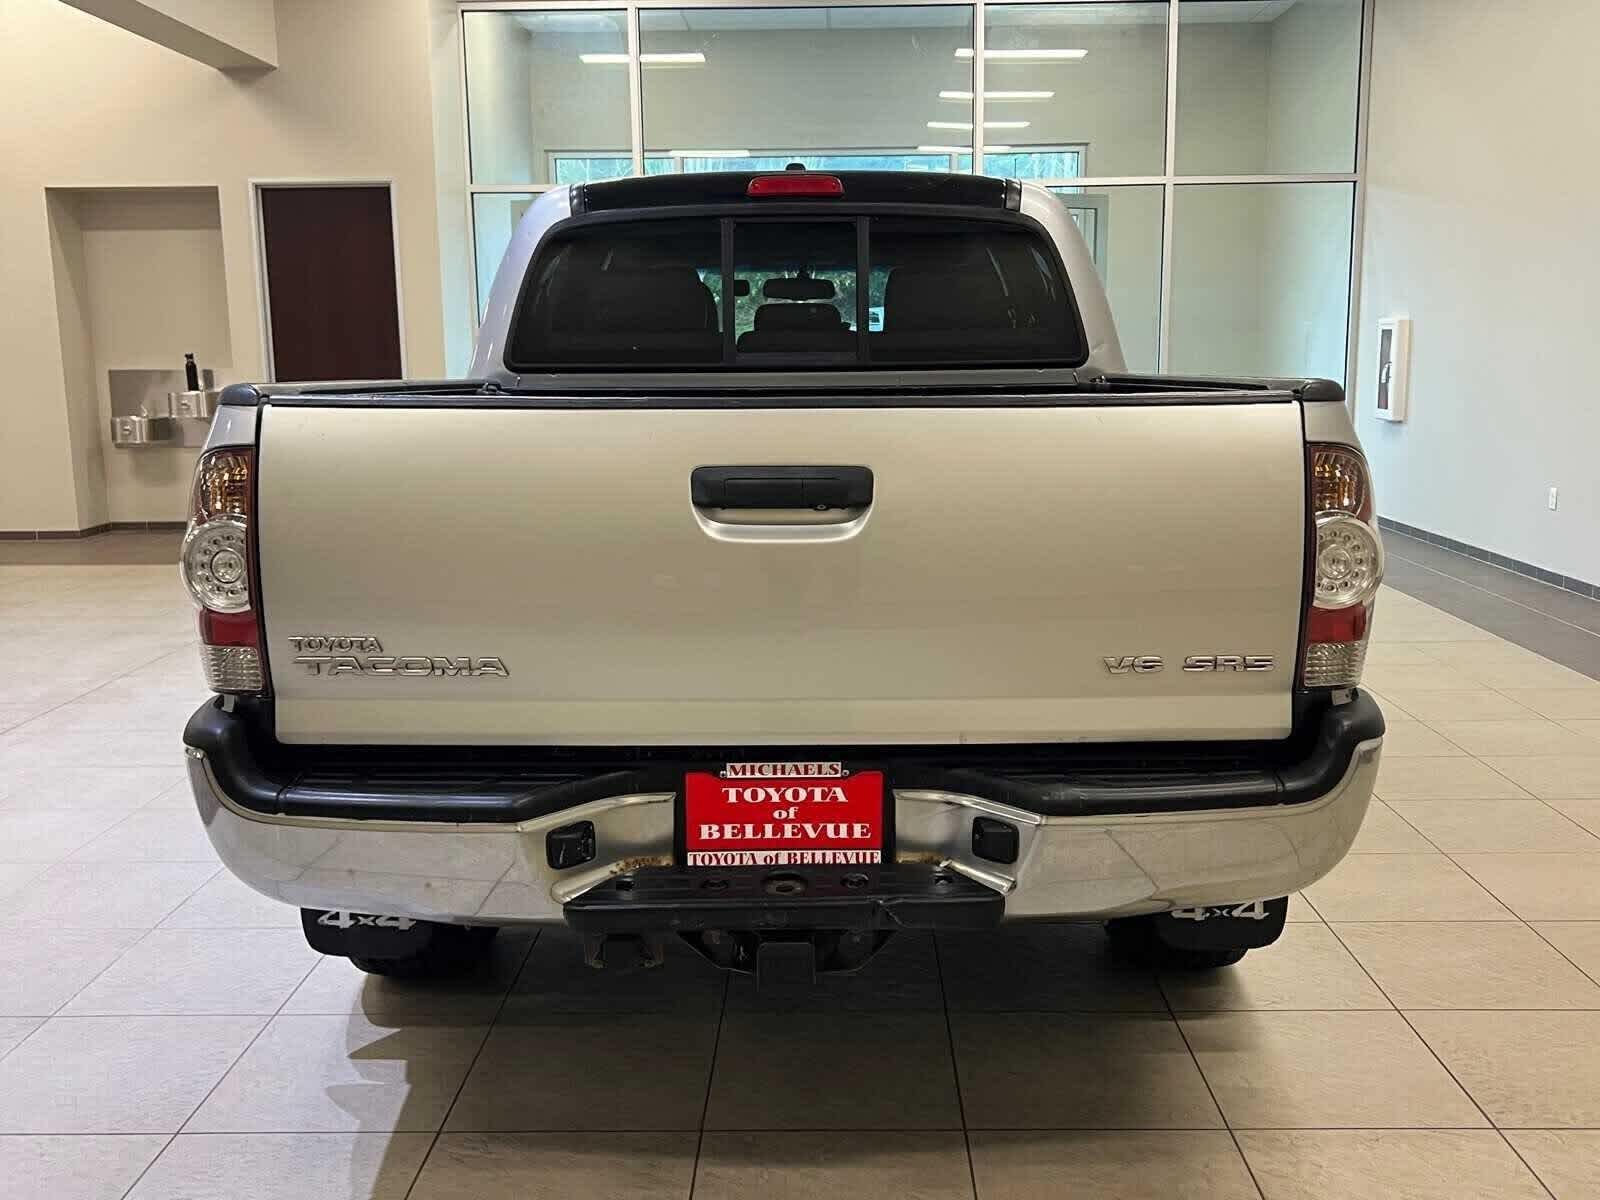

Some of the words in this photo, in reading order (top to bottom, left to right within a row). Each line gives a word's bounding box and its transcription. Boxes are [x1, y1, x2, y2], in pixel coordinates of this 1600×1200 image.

[288, 636, 383, 652] TOYOTA
[292, 656, 510, 677] TACOMA
[1103, 656, 1163, 674] V6
[1182, 655, 1274, 673] SR5
[729, 763, 840, 776] MICHAELS
[722, 786, 848, 803] TOYOTA
[773, 806, 799, 820] of
[699, 823, 872, 840] BELLEVUE
[689, 852, 758, 866] TOYOTA
[763, 852, 781, 866] of
[787, 851, 880, 865] BELLEVUE
